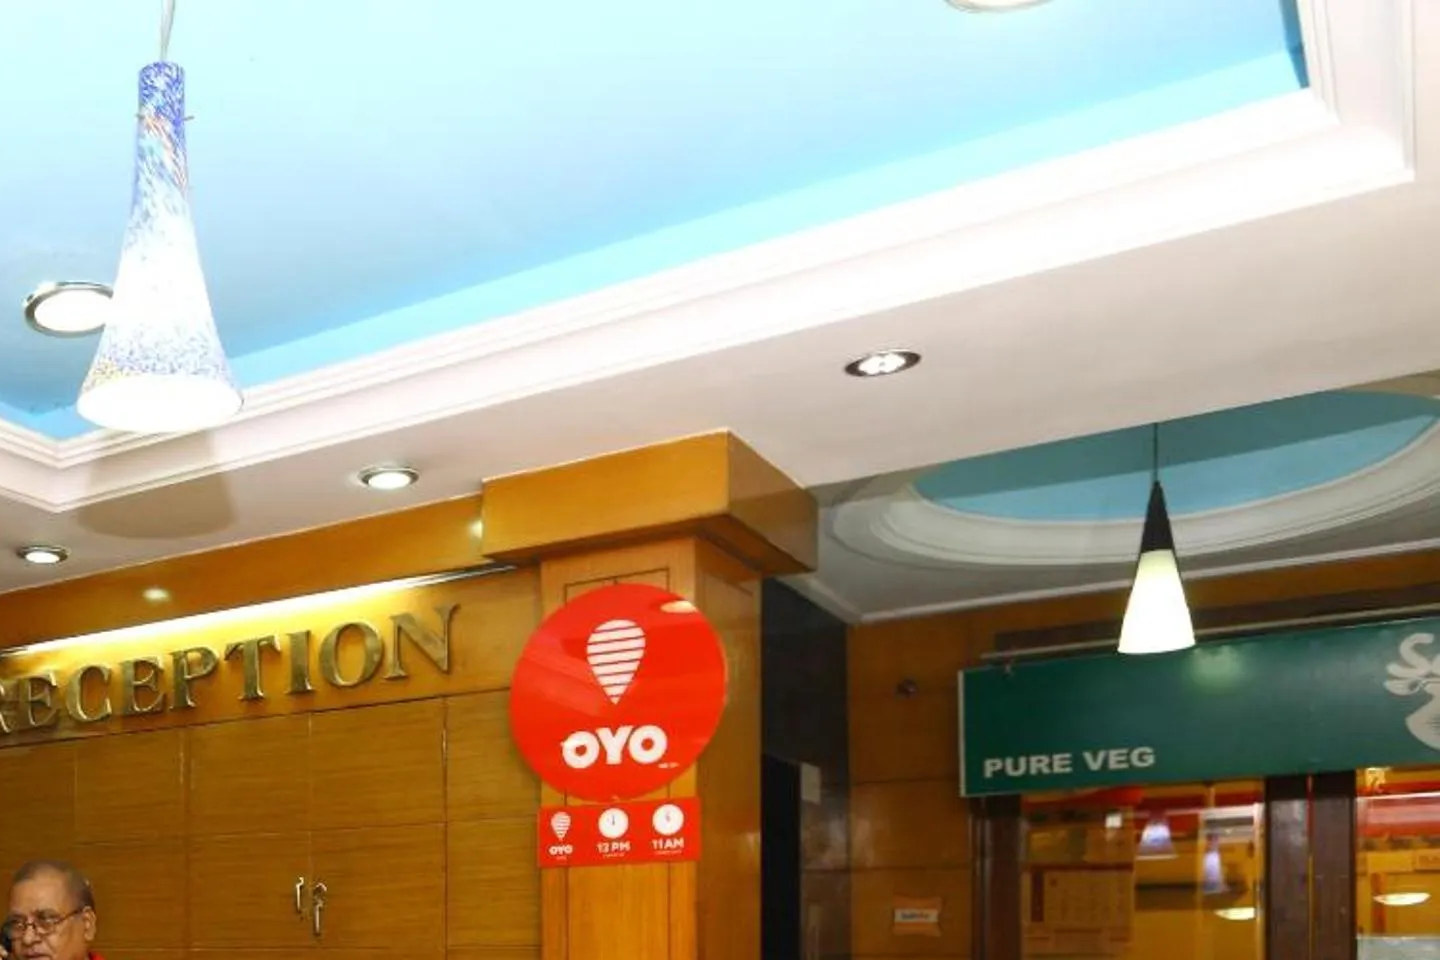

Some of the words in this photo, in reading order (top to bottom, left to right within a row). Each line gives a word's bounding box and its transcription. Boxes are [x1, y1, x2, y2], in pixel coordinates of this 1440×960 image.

[561, 725, 667, 769] OYO
[983, 752, 1073, 780] PURE
[1082, 746, 1156, 772] VEG
[611, 840, 631, 853] PM
[664, 836, 685, 849] AM
[549, 844, 573, 855] OYO
